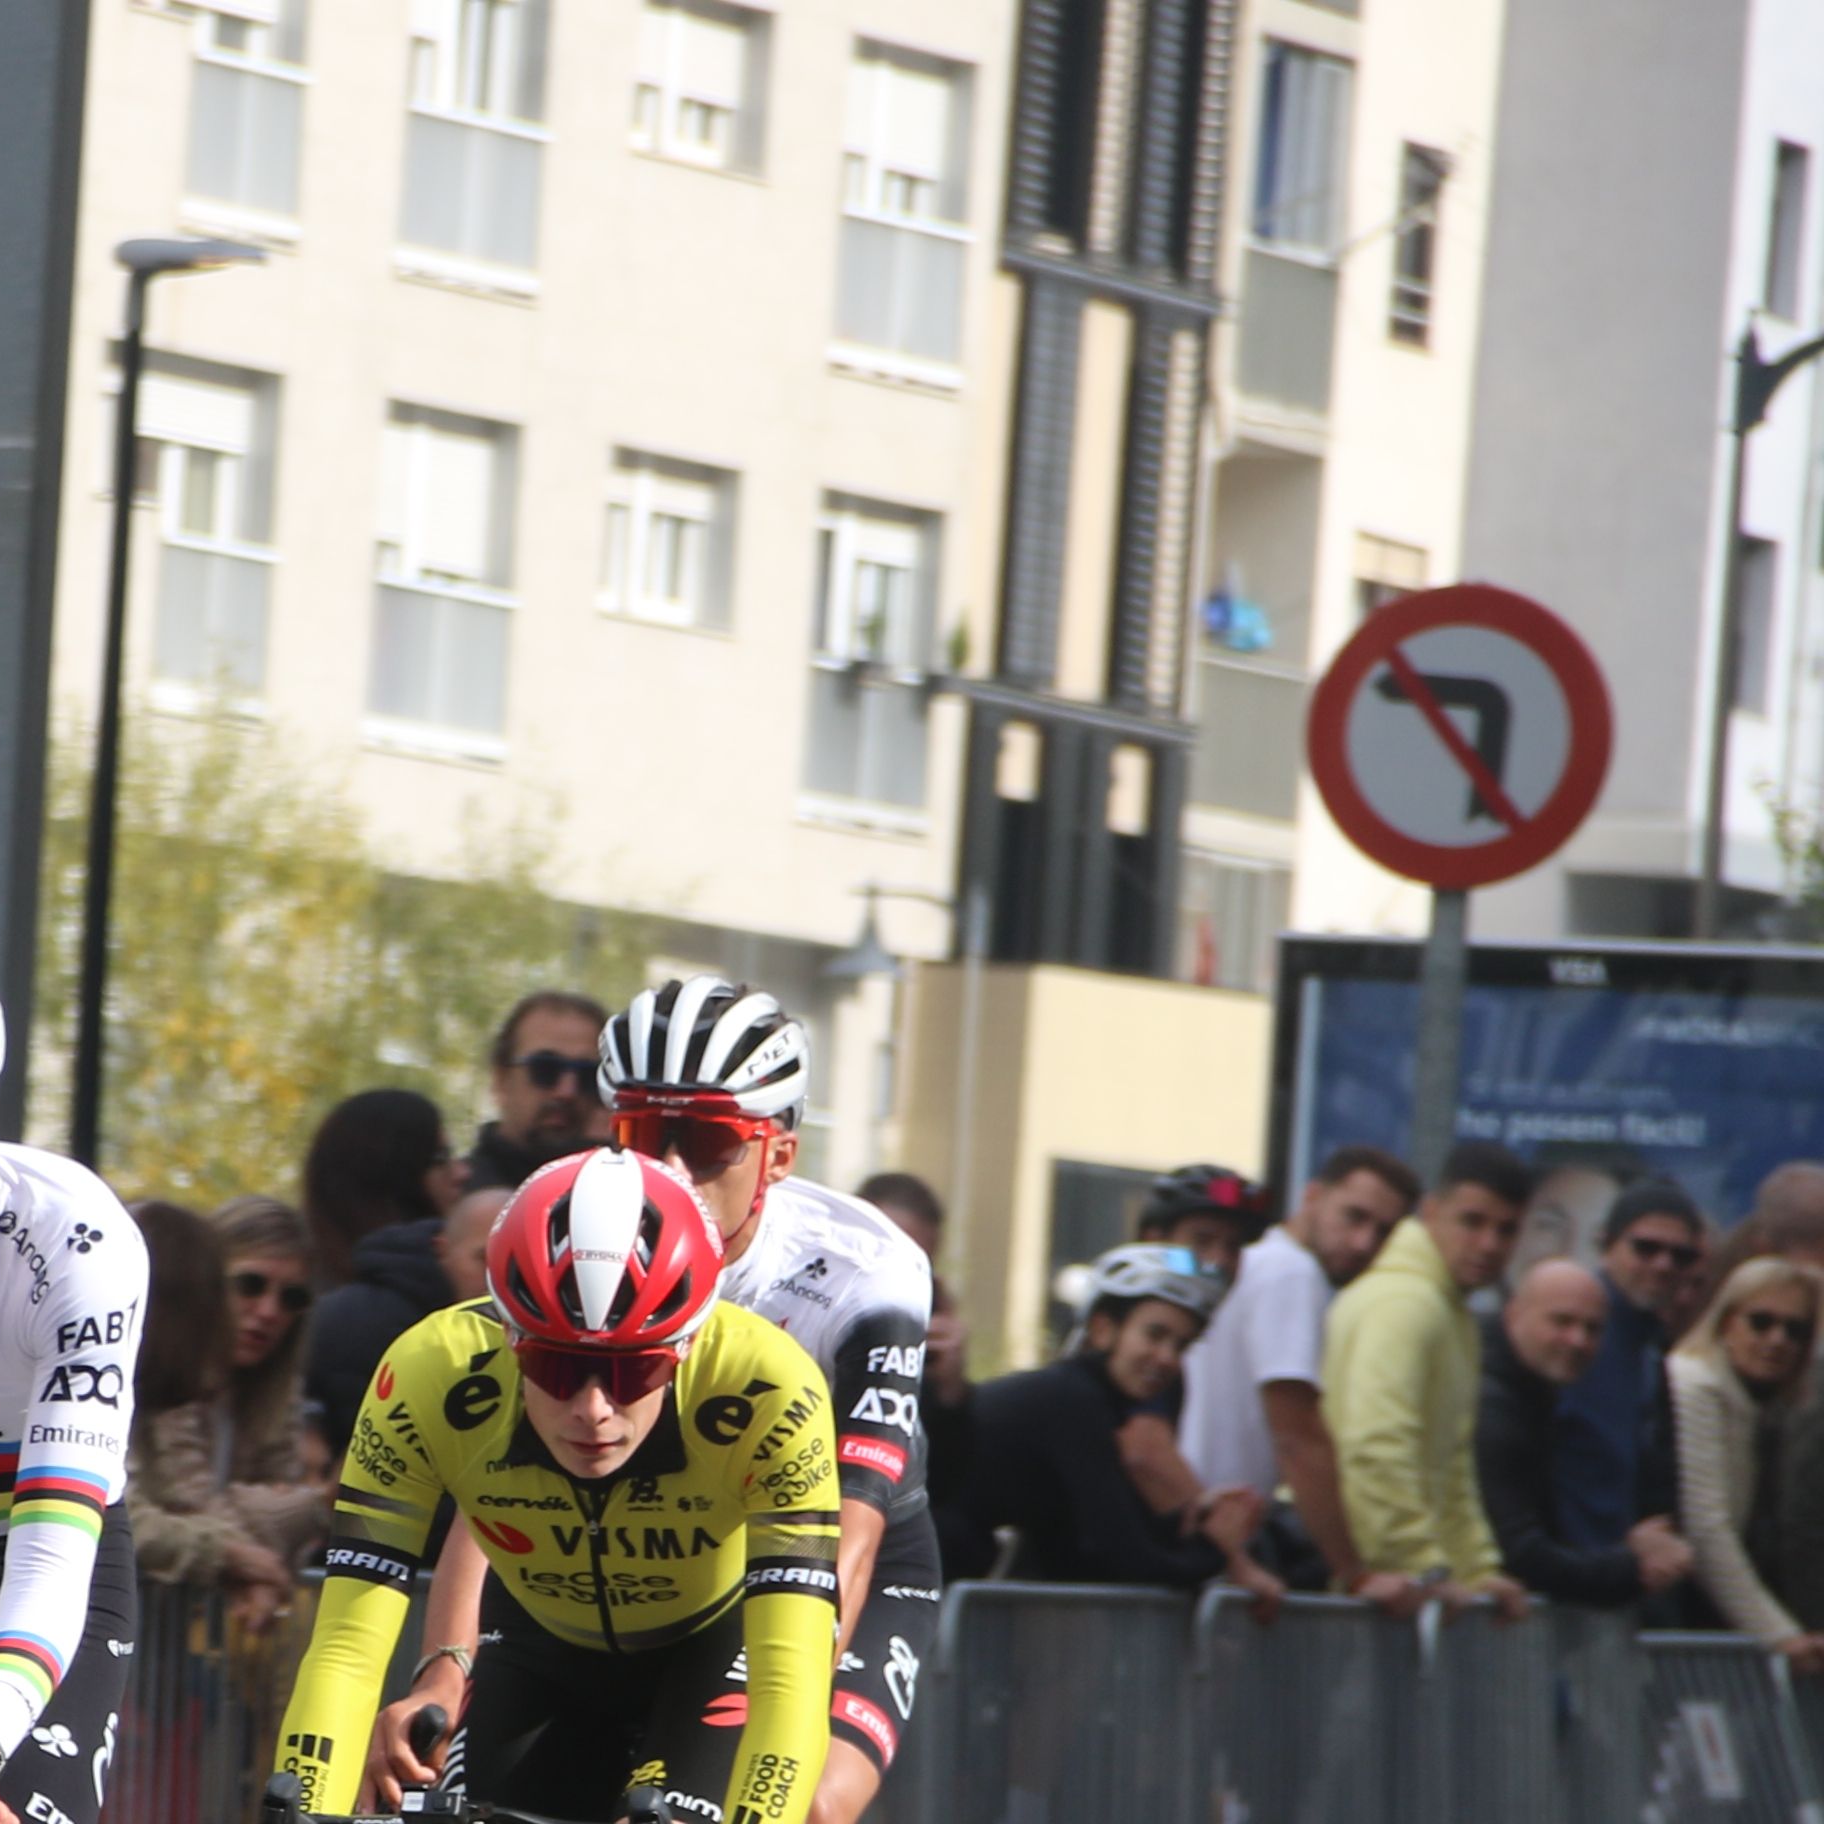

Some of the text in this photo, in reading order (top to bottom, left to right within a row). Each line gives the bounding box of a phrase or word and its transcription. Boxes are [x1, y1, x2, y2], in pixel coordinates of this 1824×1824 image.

[748, 1031, 791, 1077] MET
[57, 1310, 124, 1354] FAB
[867, 1345, 920, 1379] FAB
[39, 1363, 124, 1410] ADQ
[849, 1387, 919, 1437] ADQ
[550, 1525, 722, 1560] VISMA
[746, 1566, 837, 1592] SRAM
[749, 1753, 779, 1805] FOOD
[766, 1756, 800, 1820] COACH
